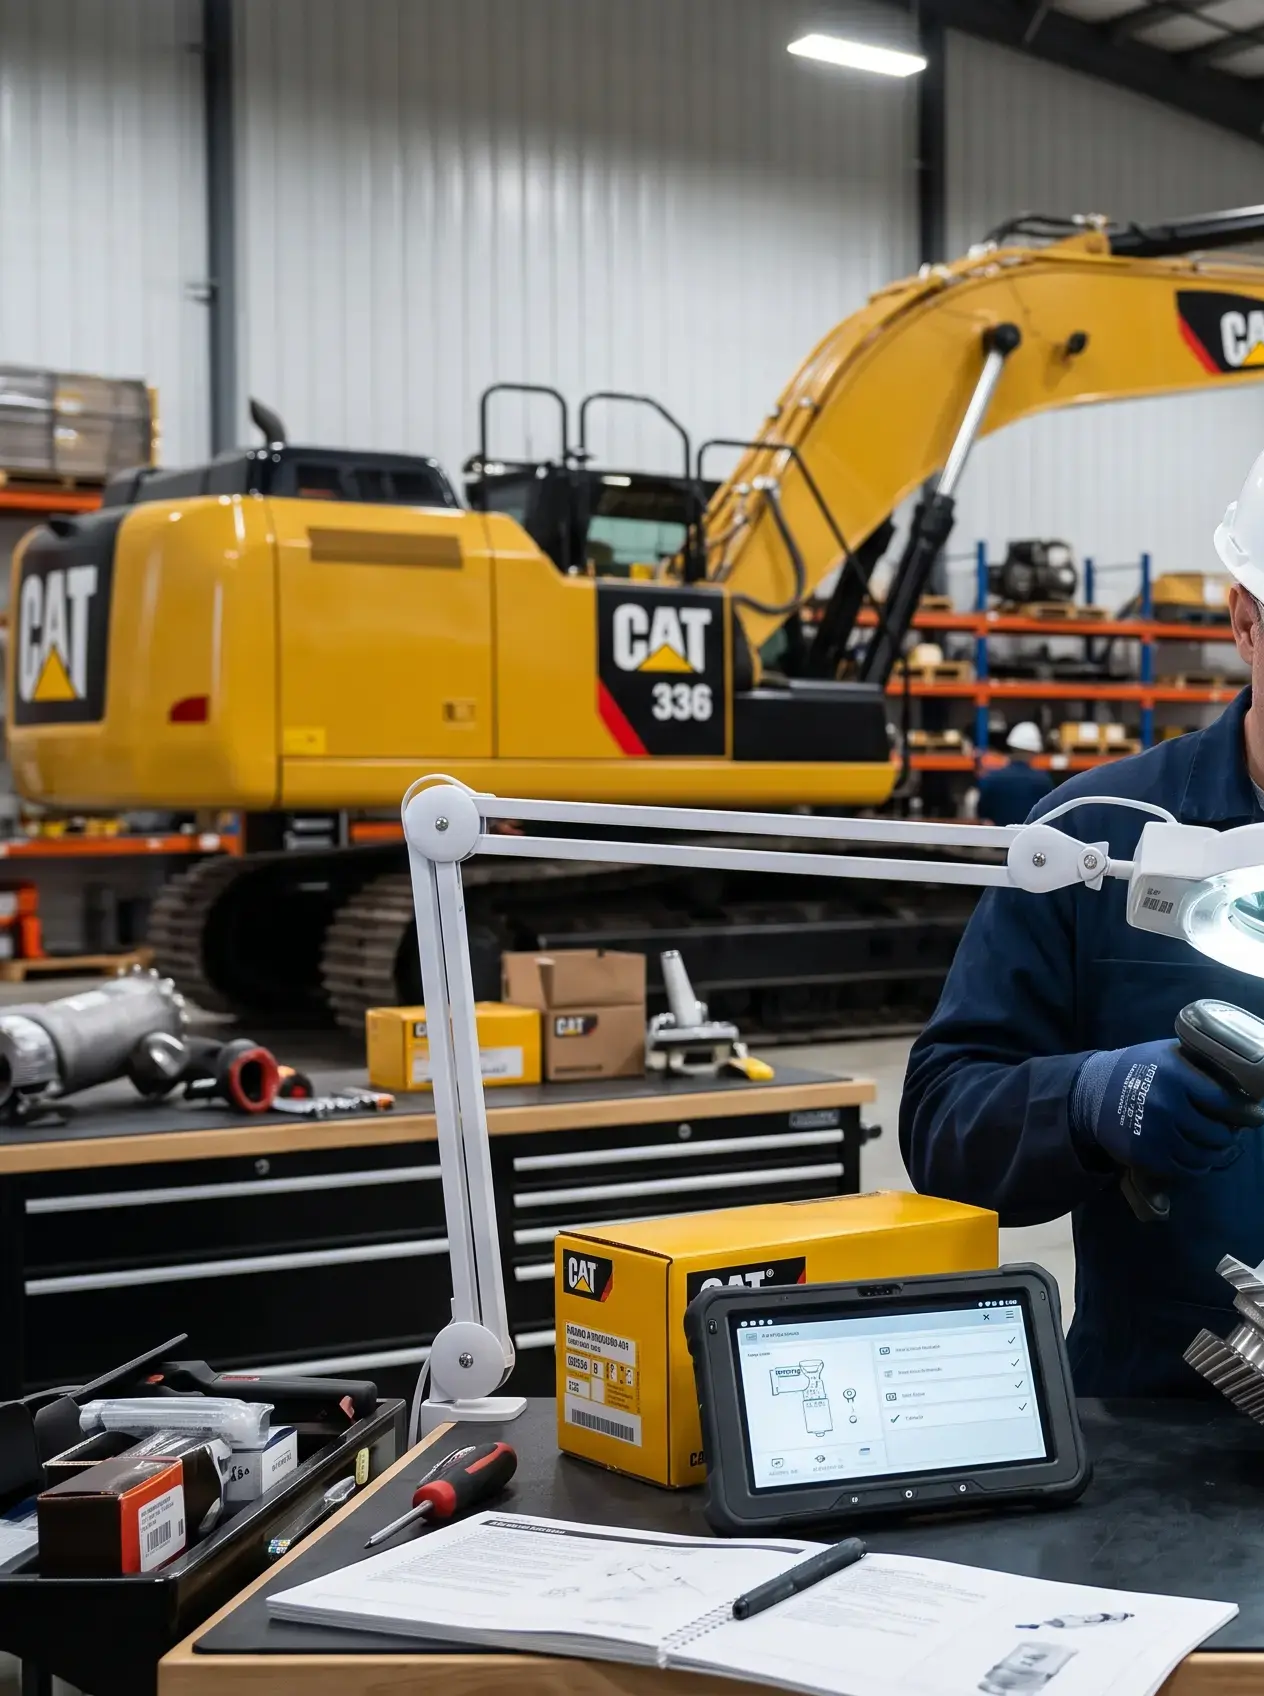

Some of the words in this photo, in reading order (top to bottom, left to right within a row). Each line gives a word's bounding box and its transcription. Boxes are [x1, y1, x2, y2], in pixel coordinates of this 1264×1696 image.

[19, 565, 98, 703] CAT
[612, 602, 712, 674] CAT
[651, 681, 713, 721] 336
[556, 1017, 586, 1037] CAT
[568, 1256, 597, 1294] CAT
